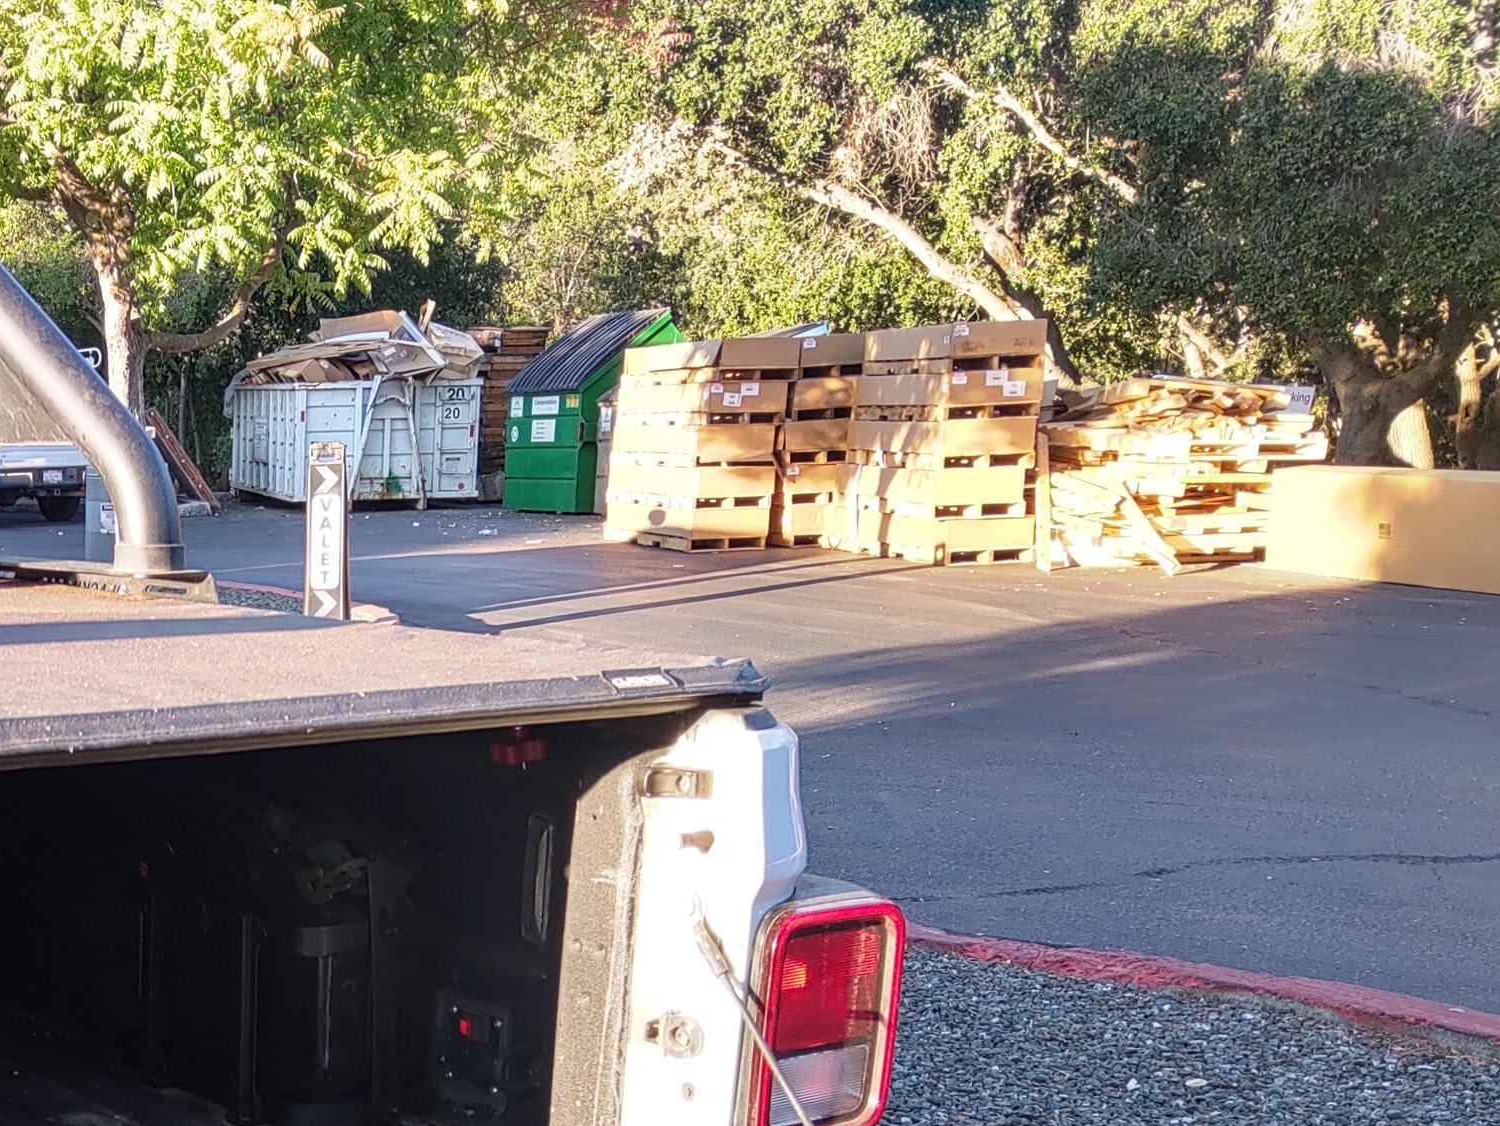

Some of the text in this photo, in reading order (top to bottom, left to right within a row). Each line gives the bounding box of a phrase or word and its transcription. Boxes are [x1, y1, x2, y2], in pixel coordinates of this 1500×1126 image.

[447, 387, 465, 401] 20
[444, 407, 461, 419] 20
[319, 498, 333, 584] VALET
